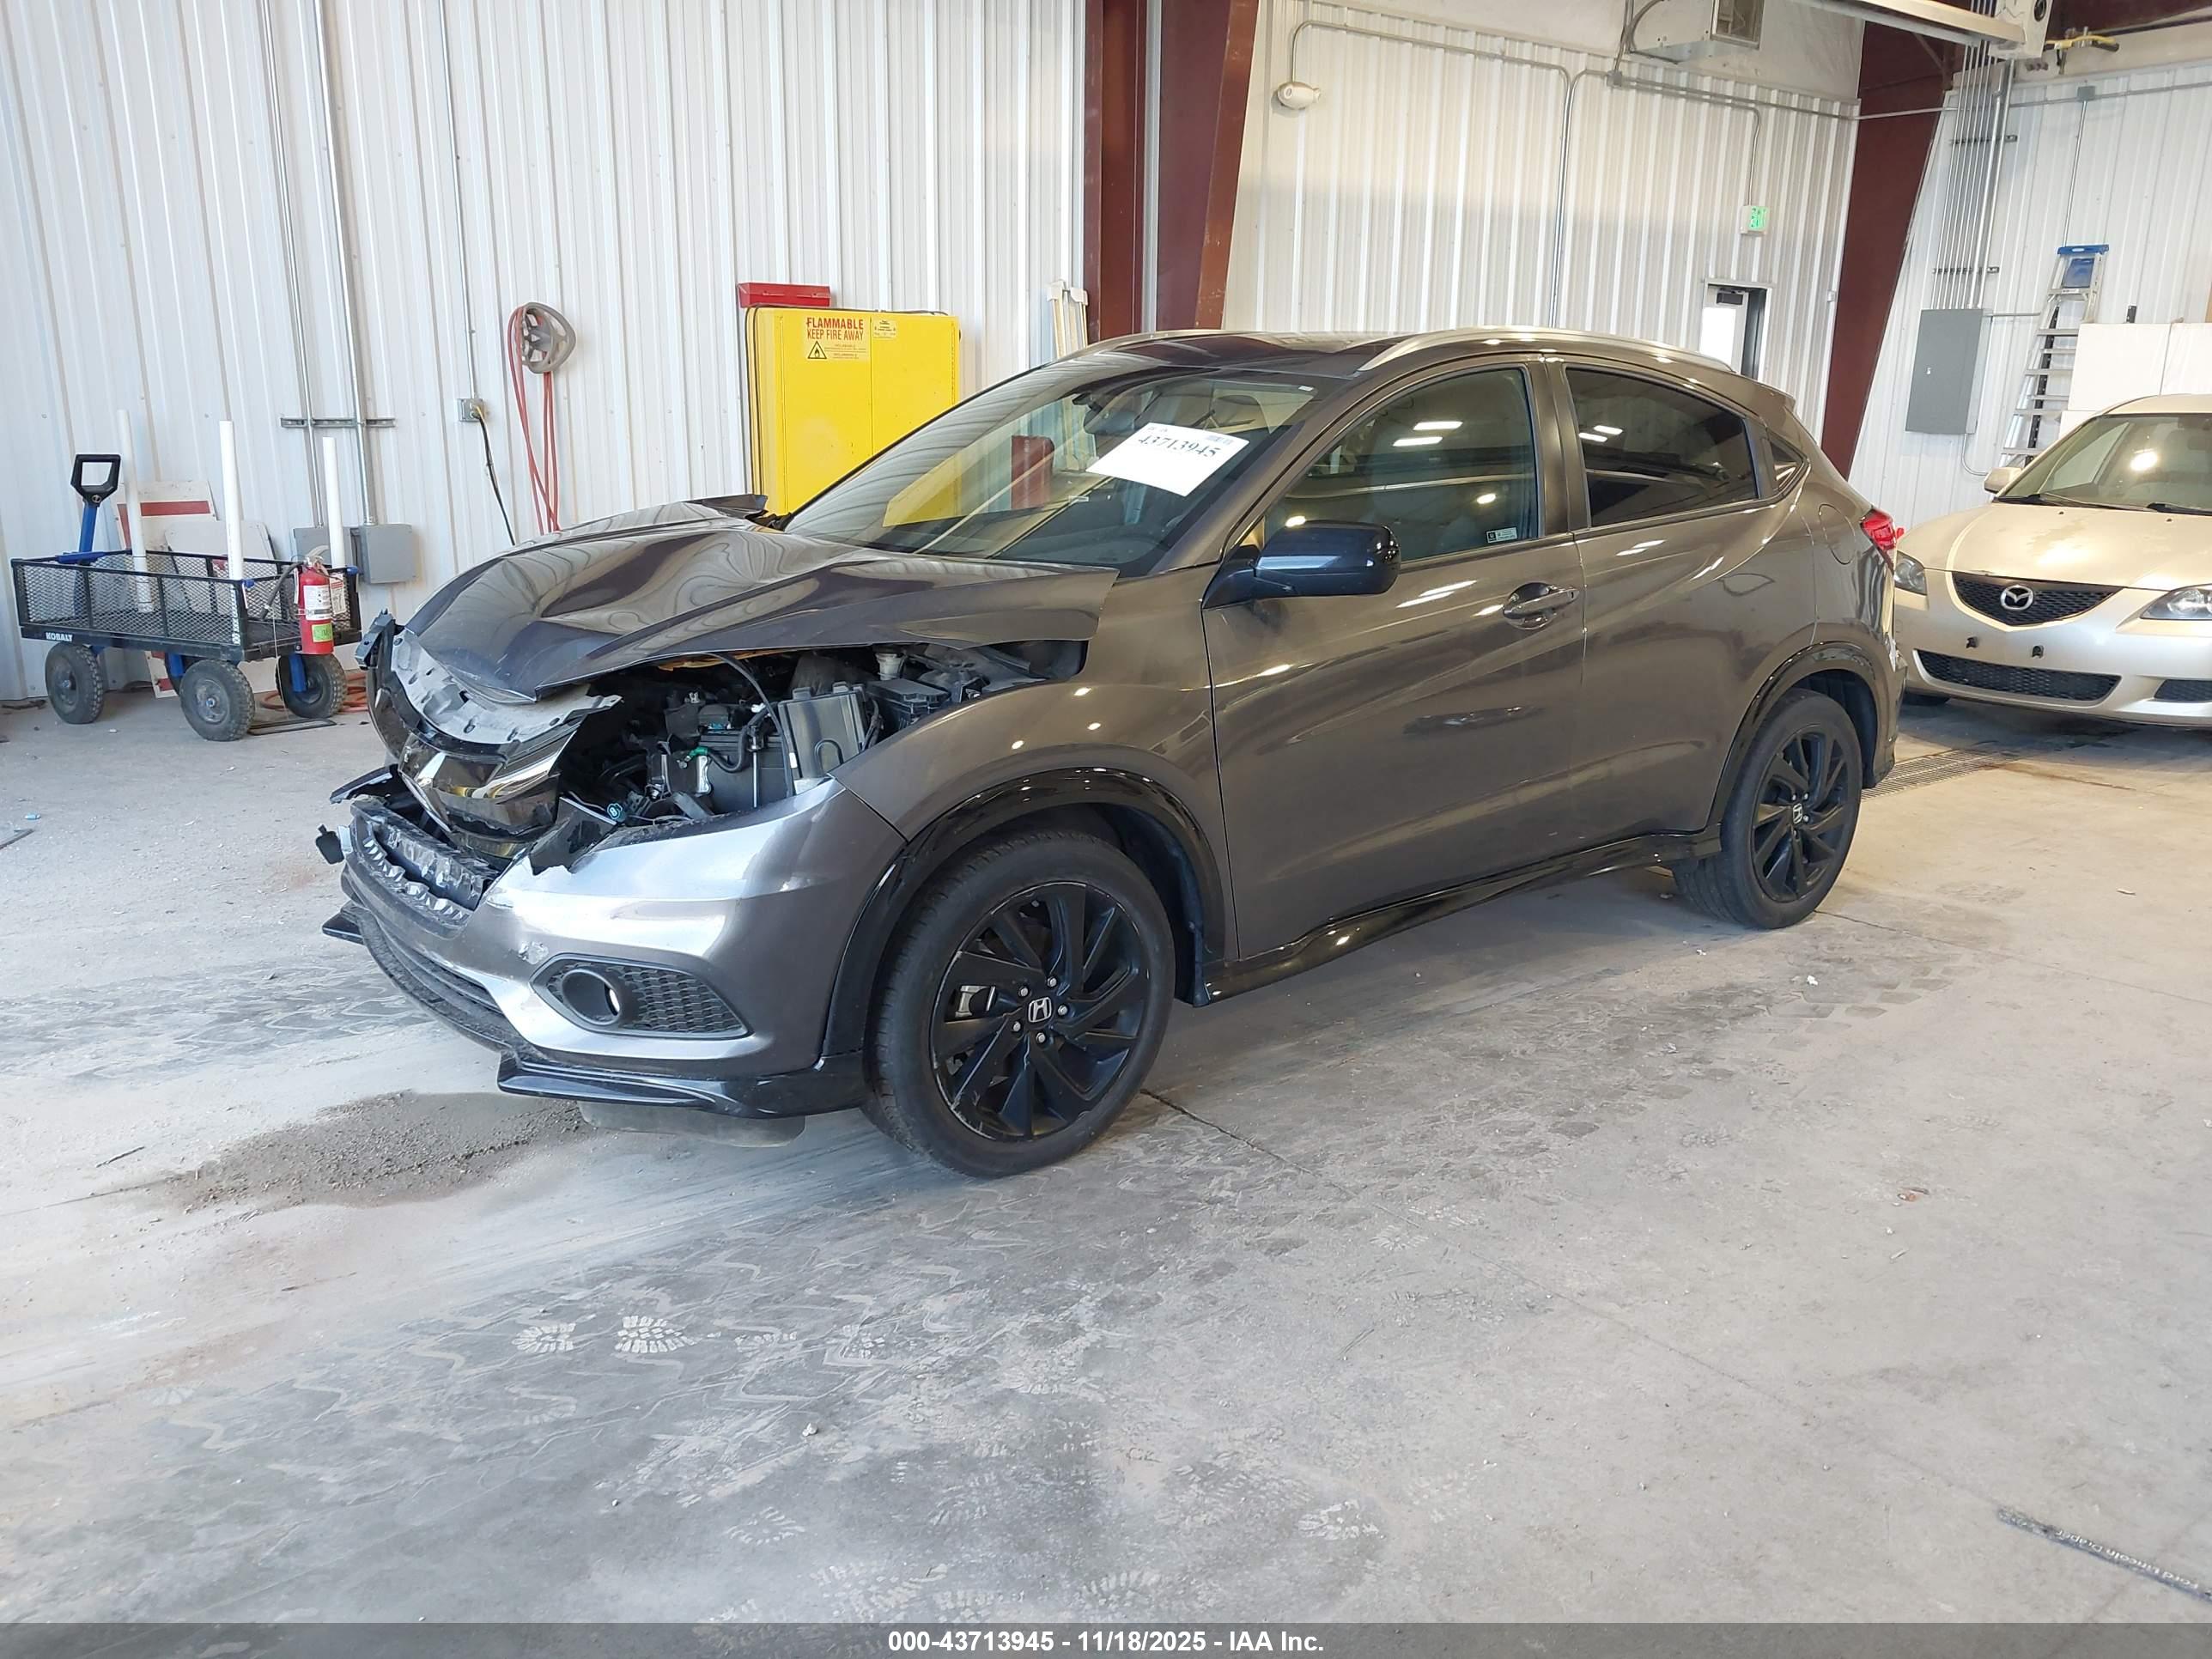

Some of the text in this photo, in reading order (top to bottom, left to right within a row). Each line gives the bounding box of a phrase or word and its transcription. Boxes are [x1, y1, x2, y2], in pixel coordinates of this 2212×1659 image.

[806, 317, 864, 330] FLAMMABLE
[807, 328, 864, 341] KEEP FIRE AWAY
[1138, 434, 1221, 457] 43713945
[46, 631, 73, 641] KOBALT
